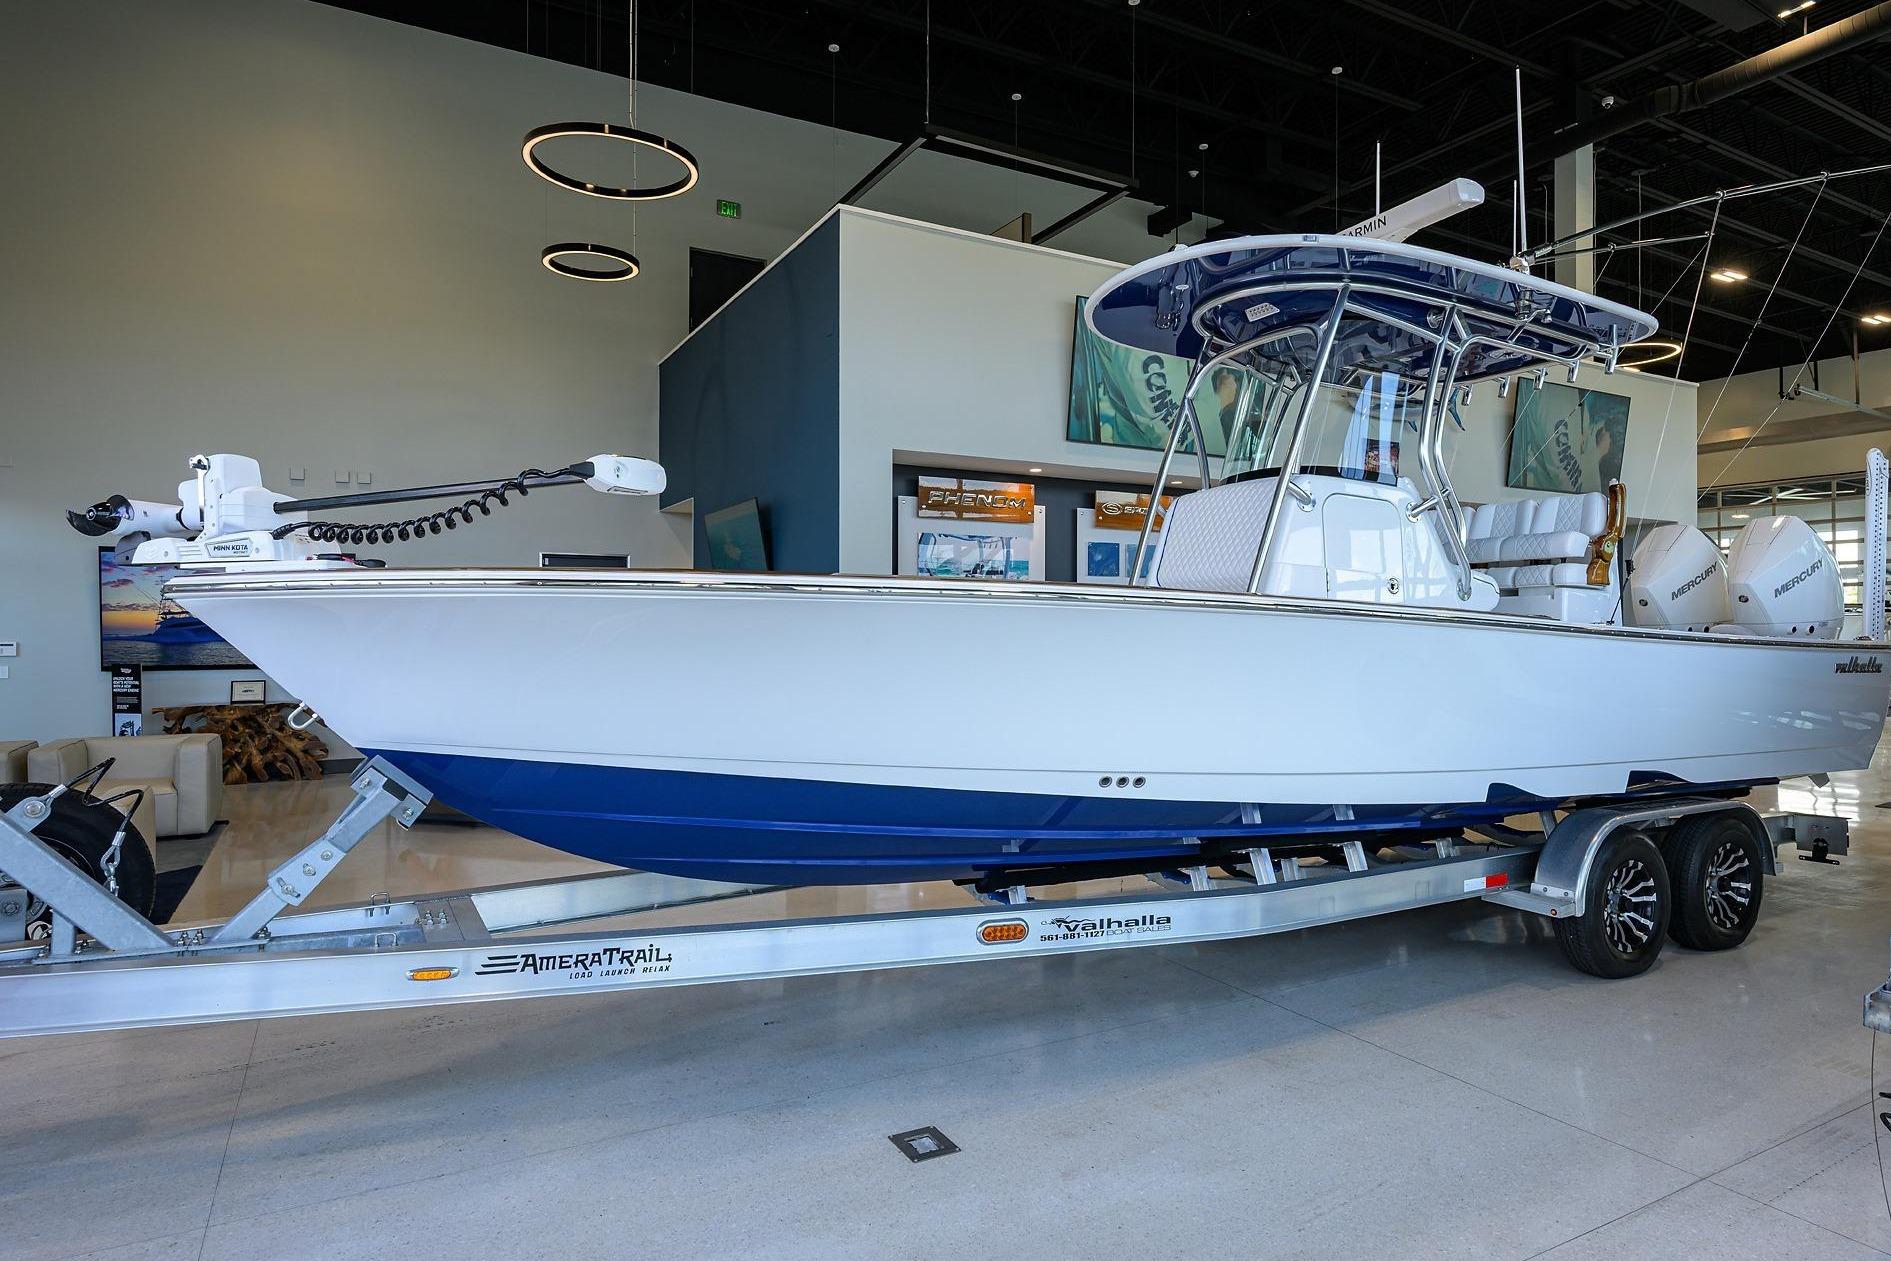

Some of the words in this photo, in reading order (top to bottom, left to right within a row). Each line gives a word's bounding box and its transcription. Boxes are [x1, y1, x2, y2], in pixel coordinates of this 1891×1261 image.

[720, 201, 737, 217] EXIT
[1343, 215, 1387, 237] ARMIN
[927, 490, 1027, 510] PHENOM
[1671, 560, 1719, 601] MERCURY
[1774, 557, 1824, 599] MERCURY
[1040, 930, 1105, 942] 561-881-1127
[1106, 928, 1135, 936] BOAT
[1136, 924, 1172, 934] SALES
[569, 971, 593, 980] LOAD
[599, 967, 636, 977] LAUNCH
[642, 964, 671, 974] RELAX
